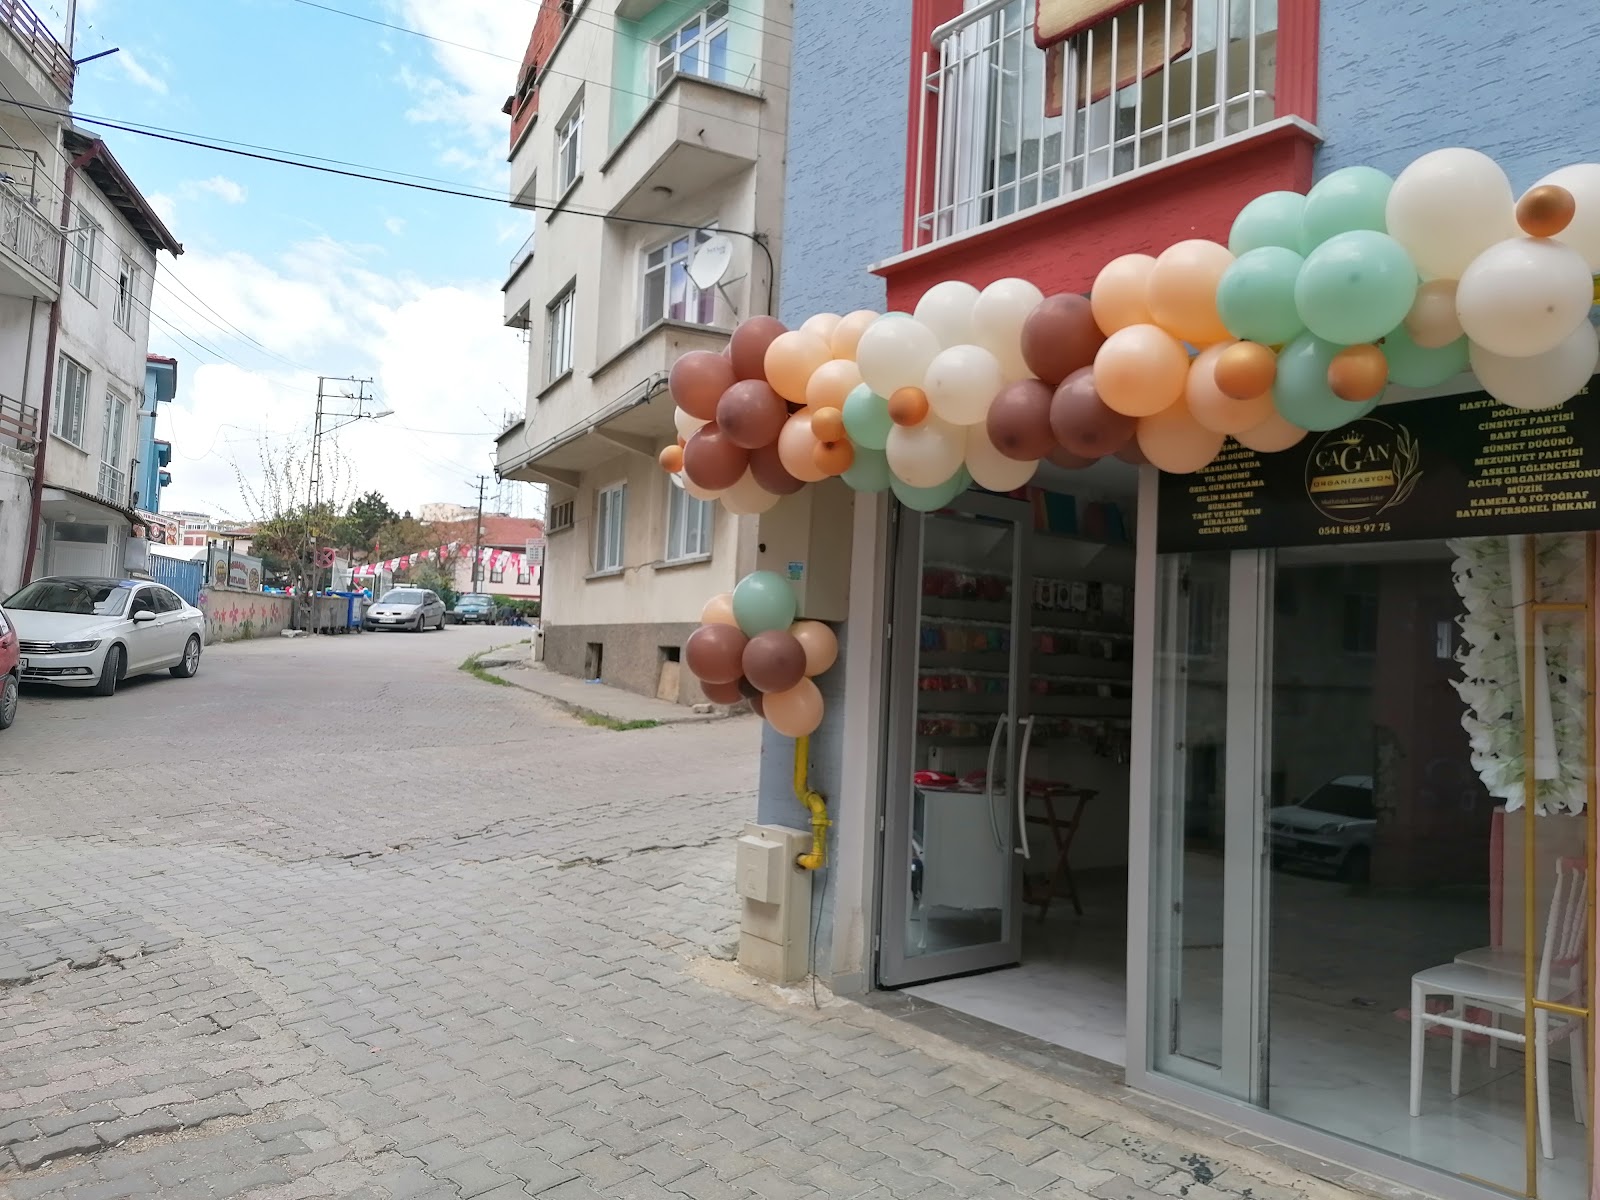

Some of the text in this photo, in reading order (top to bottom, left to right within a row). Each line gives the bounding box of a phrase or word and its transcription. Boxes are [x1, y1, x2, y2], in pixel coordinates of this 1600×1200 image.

[1478, 412, 1575, 430] CİNSİYET PARTİSİ
[1492, 408, 1530, 418] DOĞUM
[1490, 425, 1566, 440] BABY SHOWER
[1482, 436, 1574, 454] SÜNNET DÜĞÜNÜ
[1240, 460, 1261, 469] VEDA
[1474, 447, 1584, 466] MEZUNİYET PARTİSİ
[1481, 459, 1580, 476] ASKER EĞLENCESİ
[1226, 480, 1264, 490] KUTLAMA
[1314, 475, 1391, 488] ORGANİZASYON
[1468, 468, 1600, 488] AÇILIŞ ORGANİZASYONU
[1507, 484, 1543, 494] MÜZİK
[1470, 490, 1589, 507] KAMERA & FOTOĞRAF
[1456, 500, 1597, 518] BAYAN PERSONEL İMKANI
[1318, 522, 1391, 535] 0541 882 97 75
